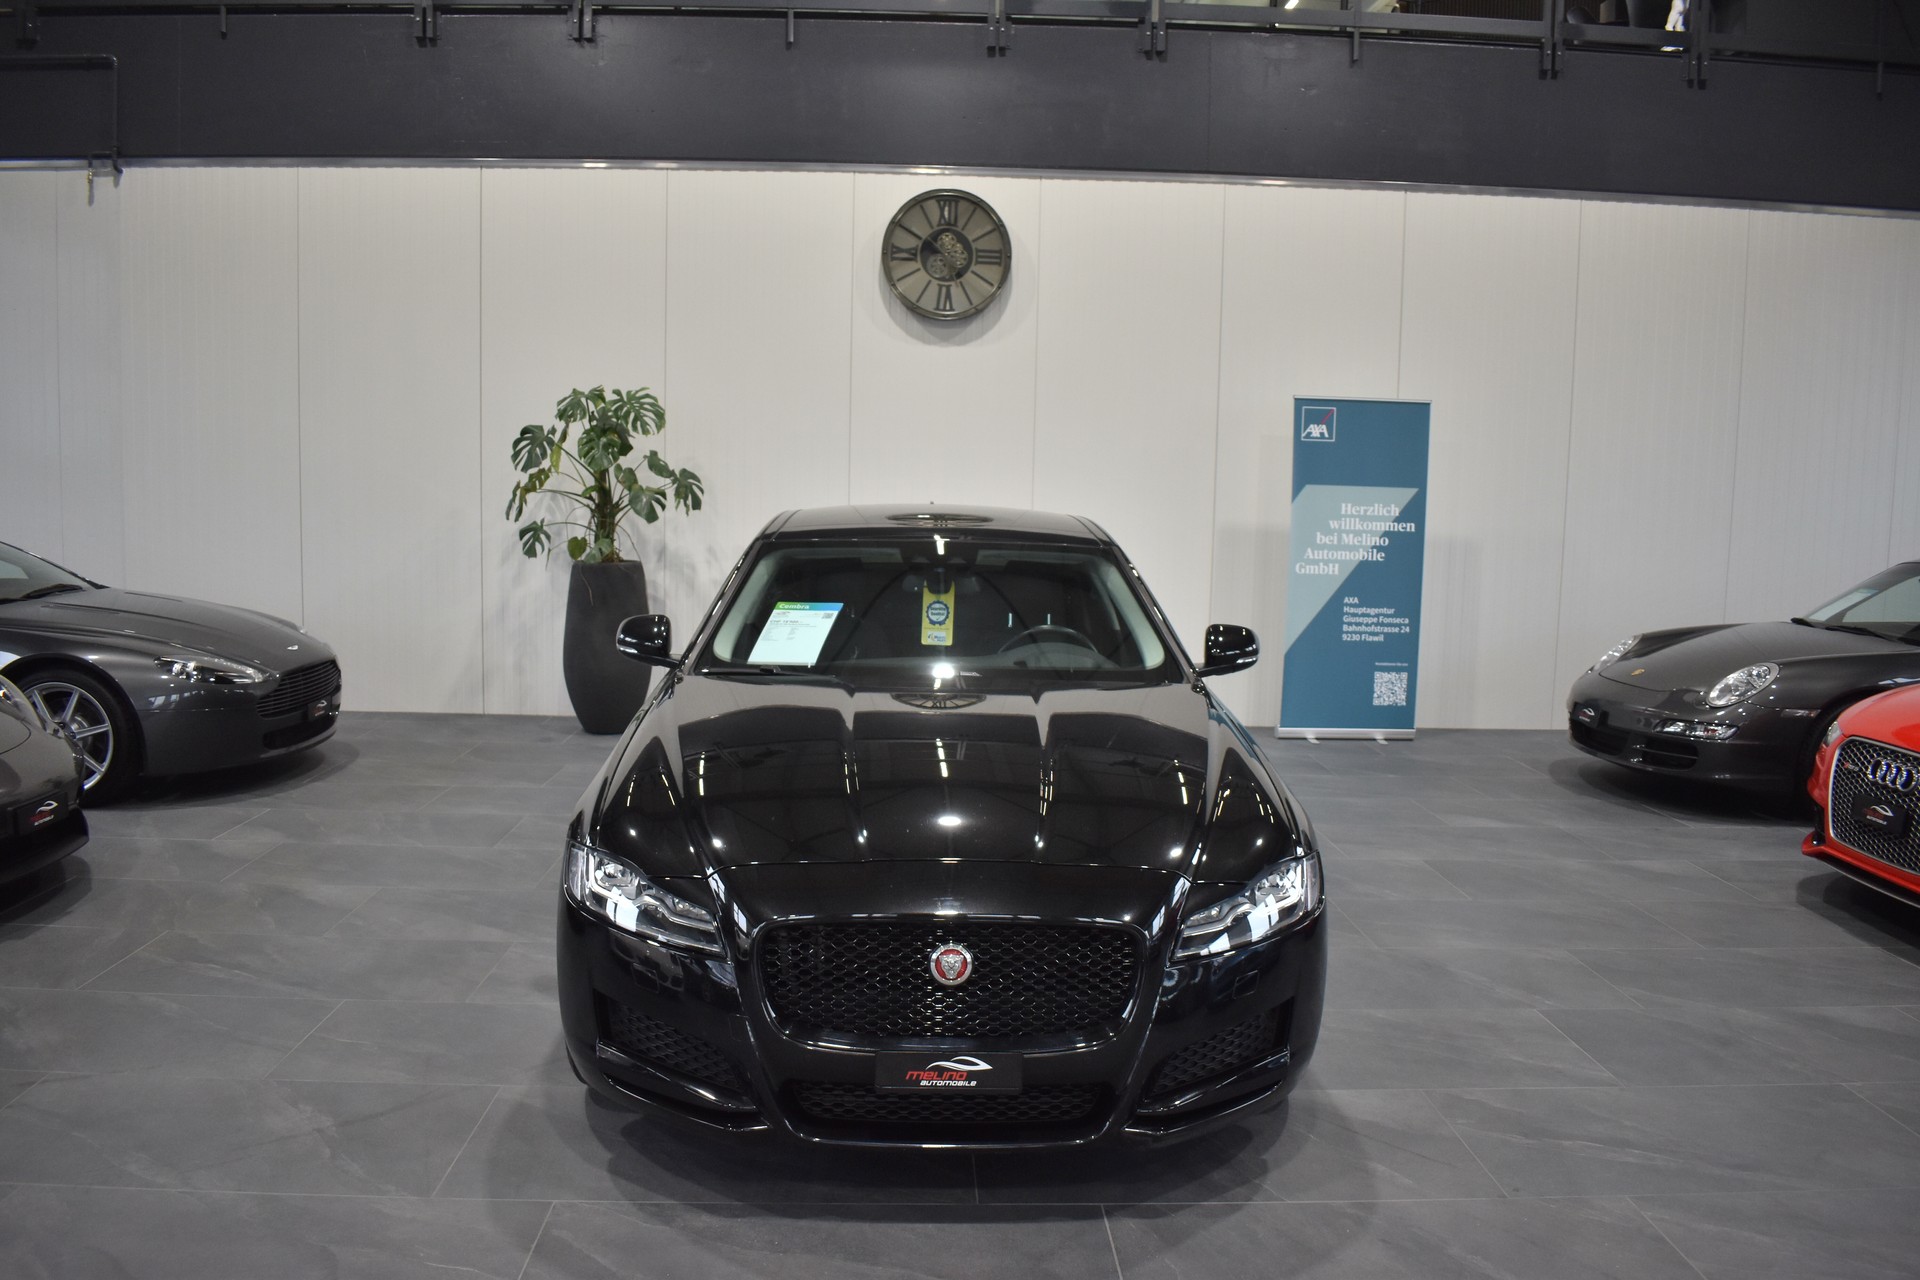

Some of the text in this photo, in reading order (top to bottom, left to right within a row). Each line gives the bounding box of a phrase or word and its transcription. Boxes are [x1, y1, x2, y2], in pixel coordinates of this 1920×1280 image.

[935, 199, 960, 227] XII
[1302, 424, 1329, 438] AXA
[1341, 503, 1400, 517] Herzlich
[1329, 518, 1416, 532] willkommen
[1316, 532, 1389, 547] bei Melino
[1304, 547, 1386, 562] Automobile
[1295, 562, 1339, 576] GmbH
[1343, 596, 1360, 604] AXA
[1343, 606, 1396, 615] Hauptagentur
[1343, 615, 1409, 624] Giuseppe Fonseca
[1342, 624, 1400, 633] Bahnhofstrasse
[1342, 633, 1385, 642] 9230 Flawil
